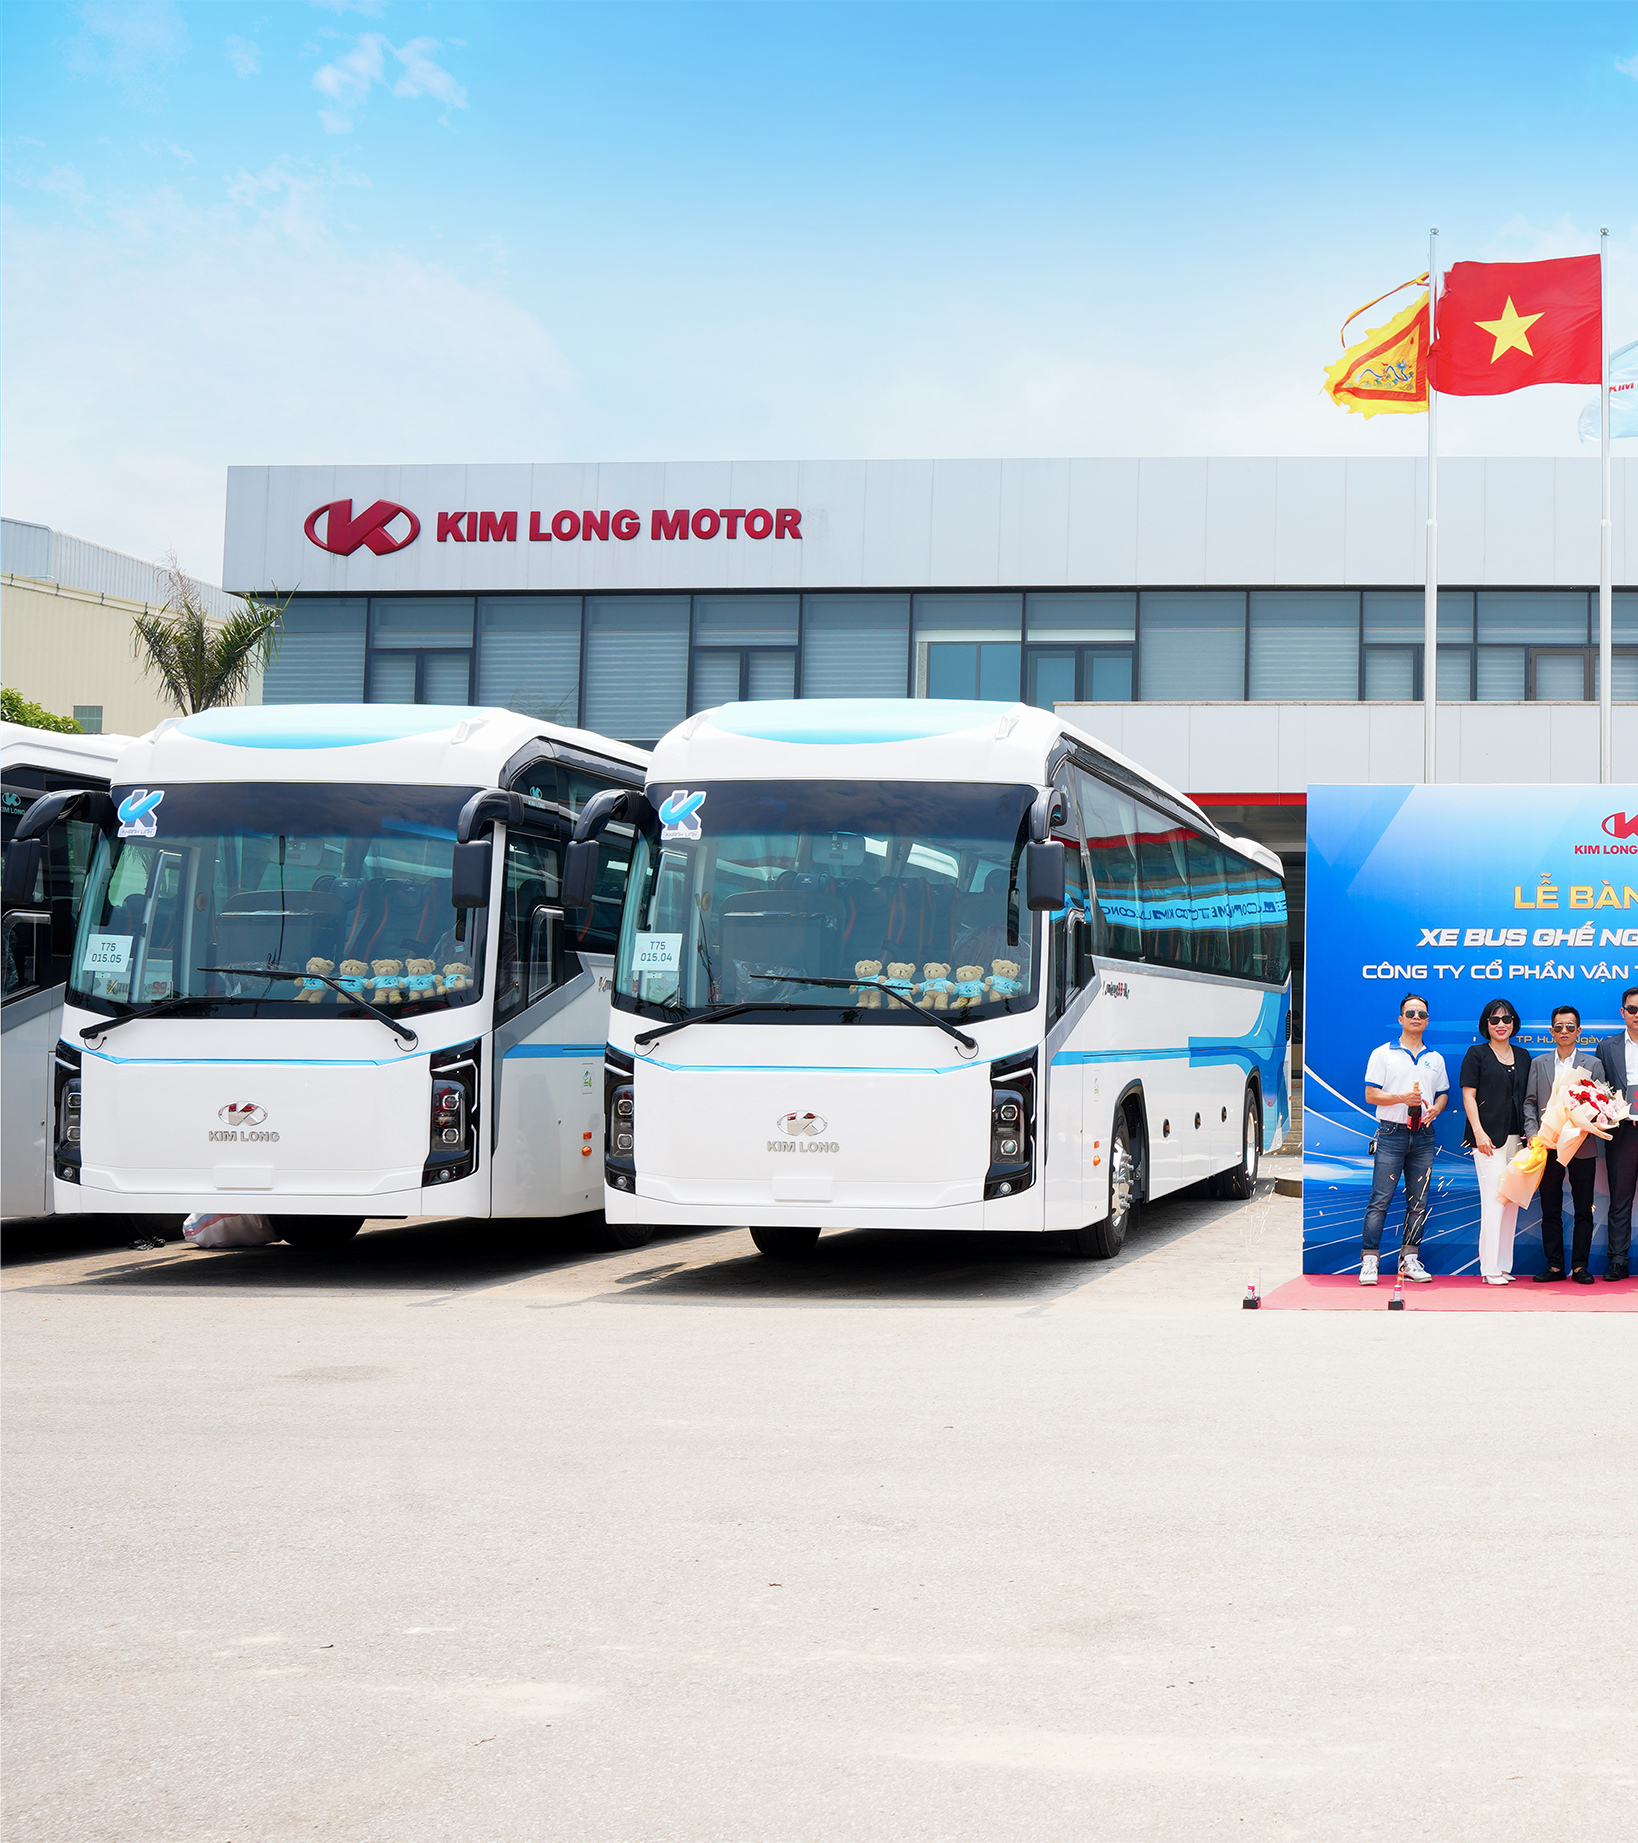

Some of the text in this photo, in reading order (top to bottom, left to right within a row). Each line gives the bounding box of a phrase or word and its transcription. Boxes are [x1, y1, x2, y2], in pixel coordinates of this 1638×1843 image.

[437, 507, 803, 543] KIM LONG MOTOR
[1574, 845, 1600, 854] KIM
[1603, 845, 1638, 855] LONG
[1514, 872, 1559, 909] LỄ
[1416, 928, 1460, 947] XE
[1463, 928, 1528, 947] BUS
[1532, 920, 1595, 947] GHẾ
[101, 942, 117, 952] T75
[650, 941, 666, 951] T75
[91, 953, 122, 963] 015.05
[640, 952, 673, 962] 015.04
[1362, 961, 1428, 980] CÔNG
[1433, 965, 1466, 980] TY
[1470, 959, 1503, 980] CỔ
[1508, 959, 1575, 980] PHẦN
[1580, 961, 1630, 983] VẬN
[1516, 1035, 1534, 1043] TP.
[1537, 1035, 1557, 1044] Hu
[208, 1130, 280, 1142] KIM LONG
[767, 1141, 840, 1153] KIM LONG
